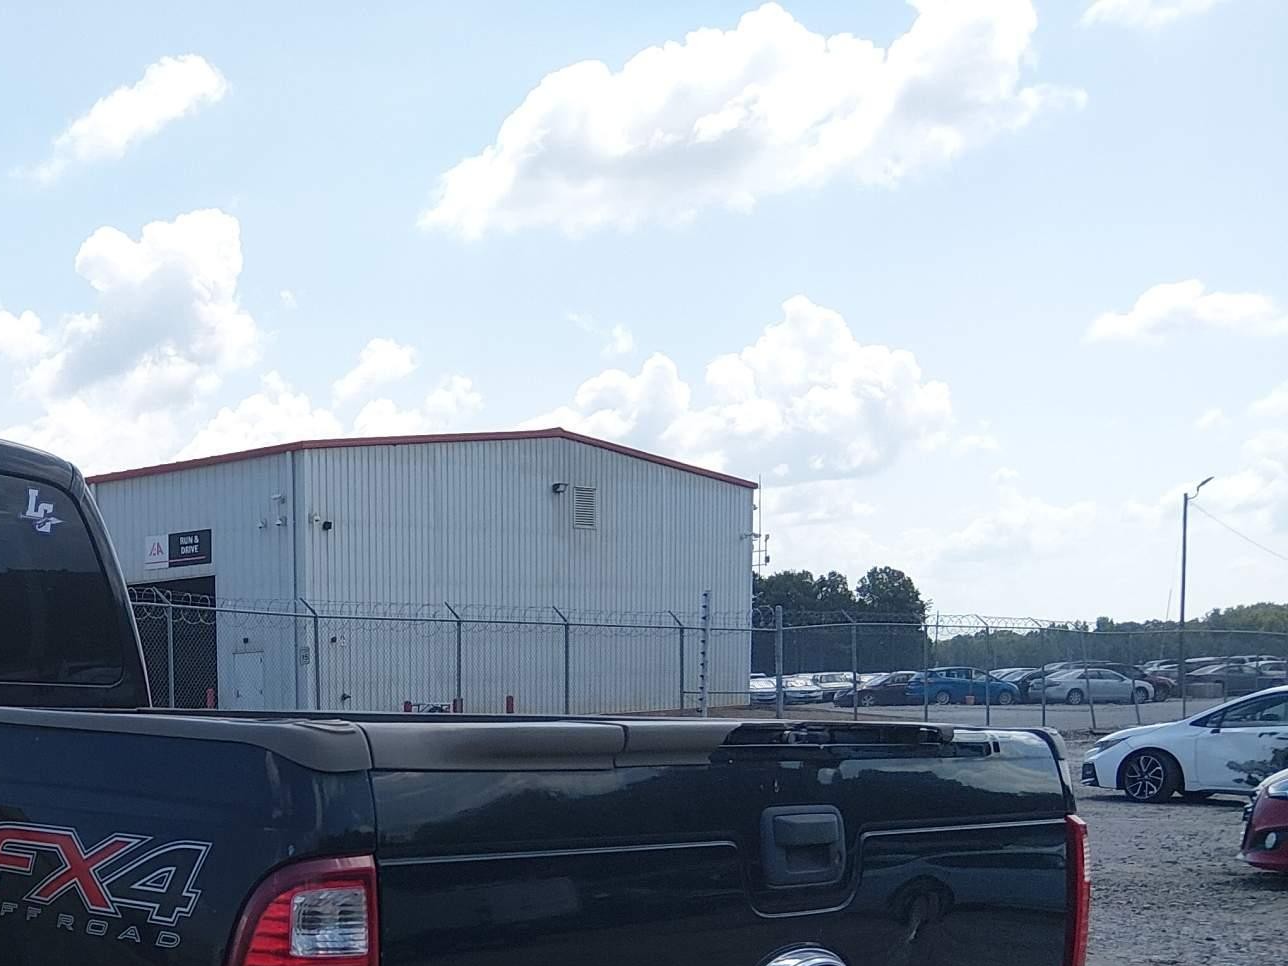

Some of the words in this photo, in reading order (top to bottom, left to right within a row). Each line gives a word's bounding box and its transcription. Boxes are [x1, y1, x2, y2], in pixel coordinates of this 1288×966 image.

[179, 536, 193, 545] RUN
[180, 544, 200, 555] DRIVE
[57, 913, 181, 949] ROAD
